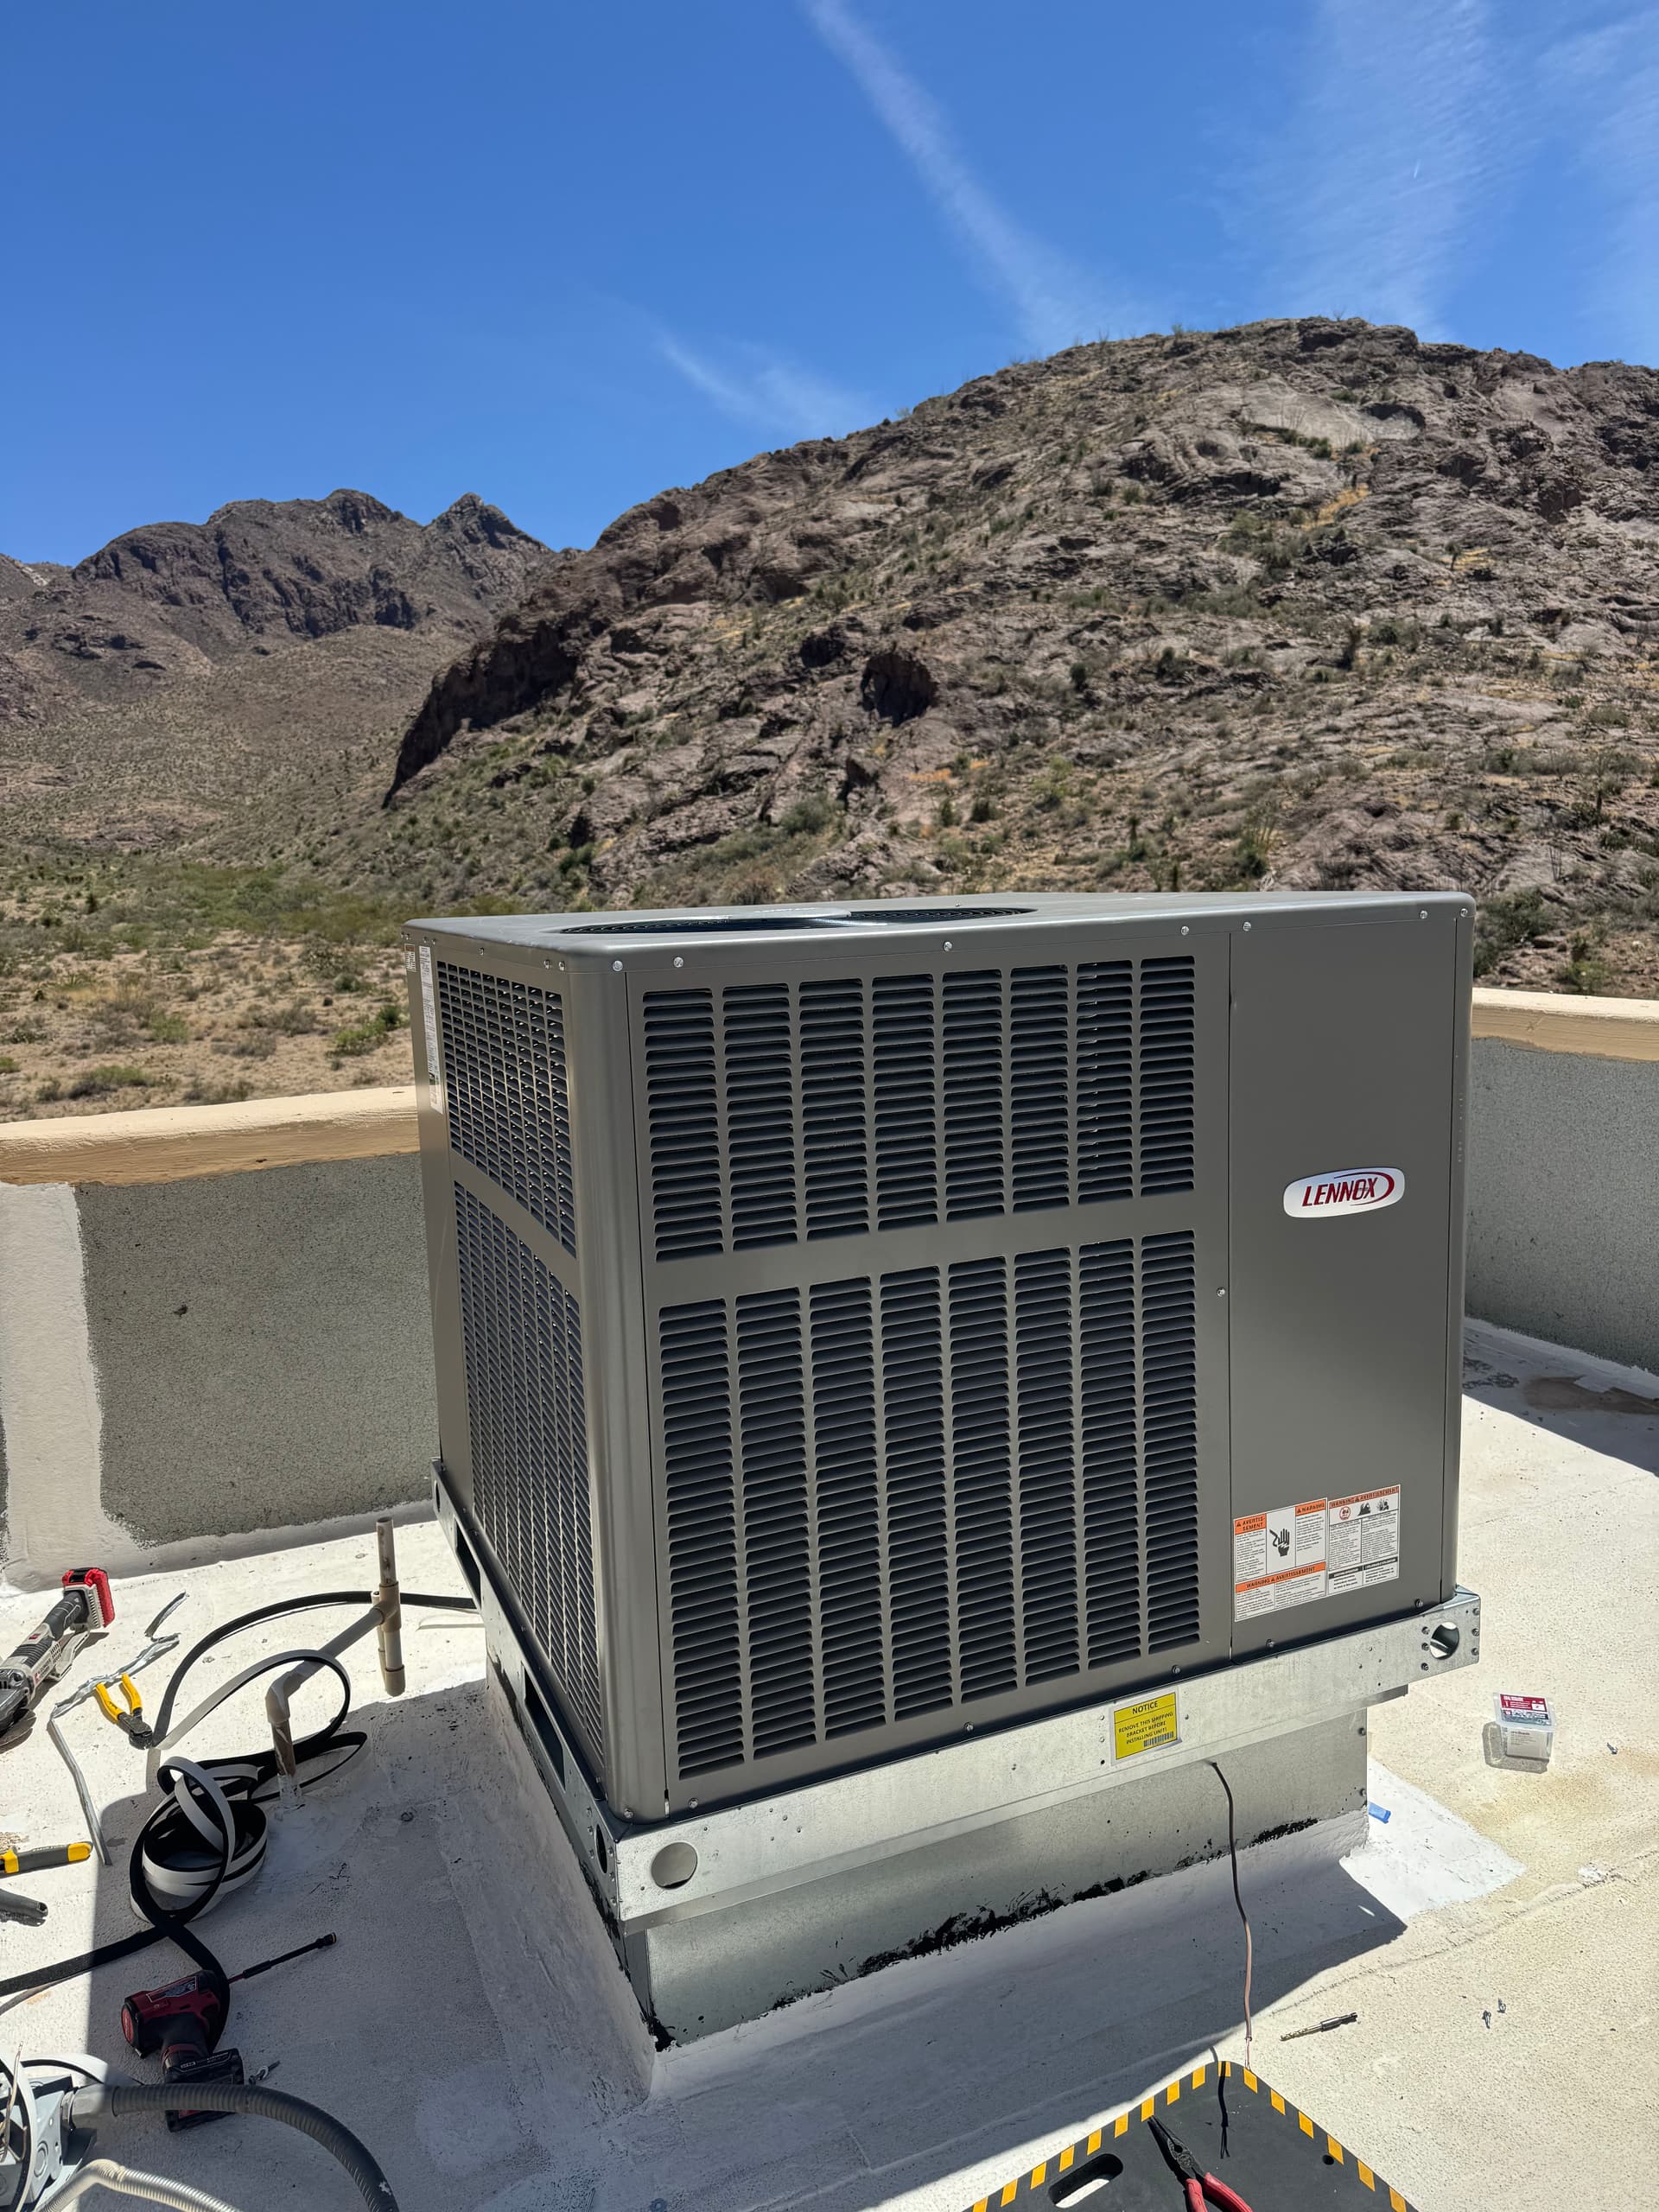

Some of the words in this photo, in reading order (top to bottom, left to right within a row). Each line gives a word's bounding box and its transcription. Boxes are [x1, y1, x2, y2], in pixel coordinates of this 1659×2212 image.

[1302, 1177, 1378, 1207] LENNOX
[1246, 1578, 1270, 1588] WARNING
[1132, 1701, 1158, 1714] NOTICE
[1118, 1722, 1139, 1733] REMOVE
[1151, 1712, 1173, 1723] SHIPPING
[1126, 1726, 1147, 1738] BRACKET
[1148, 1721, 1166, 1730] BEFORE
[1126, 1732, 1154, 1745] INSTALLING
